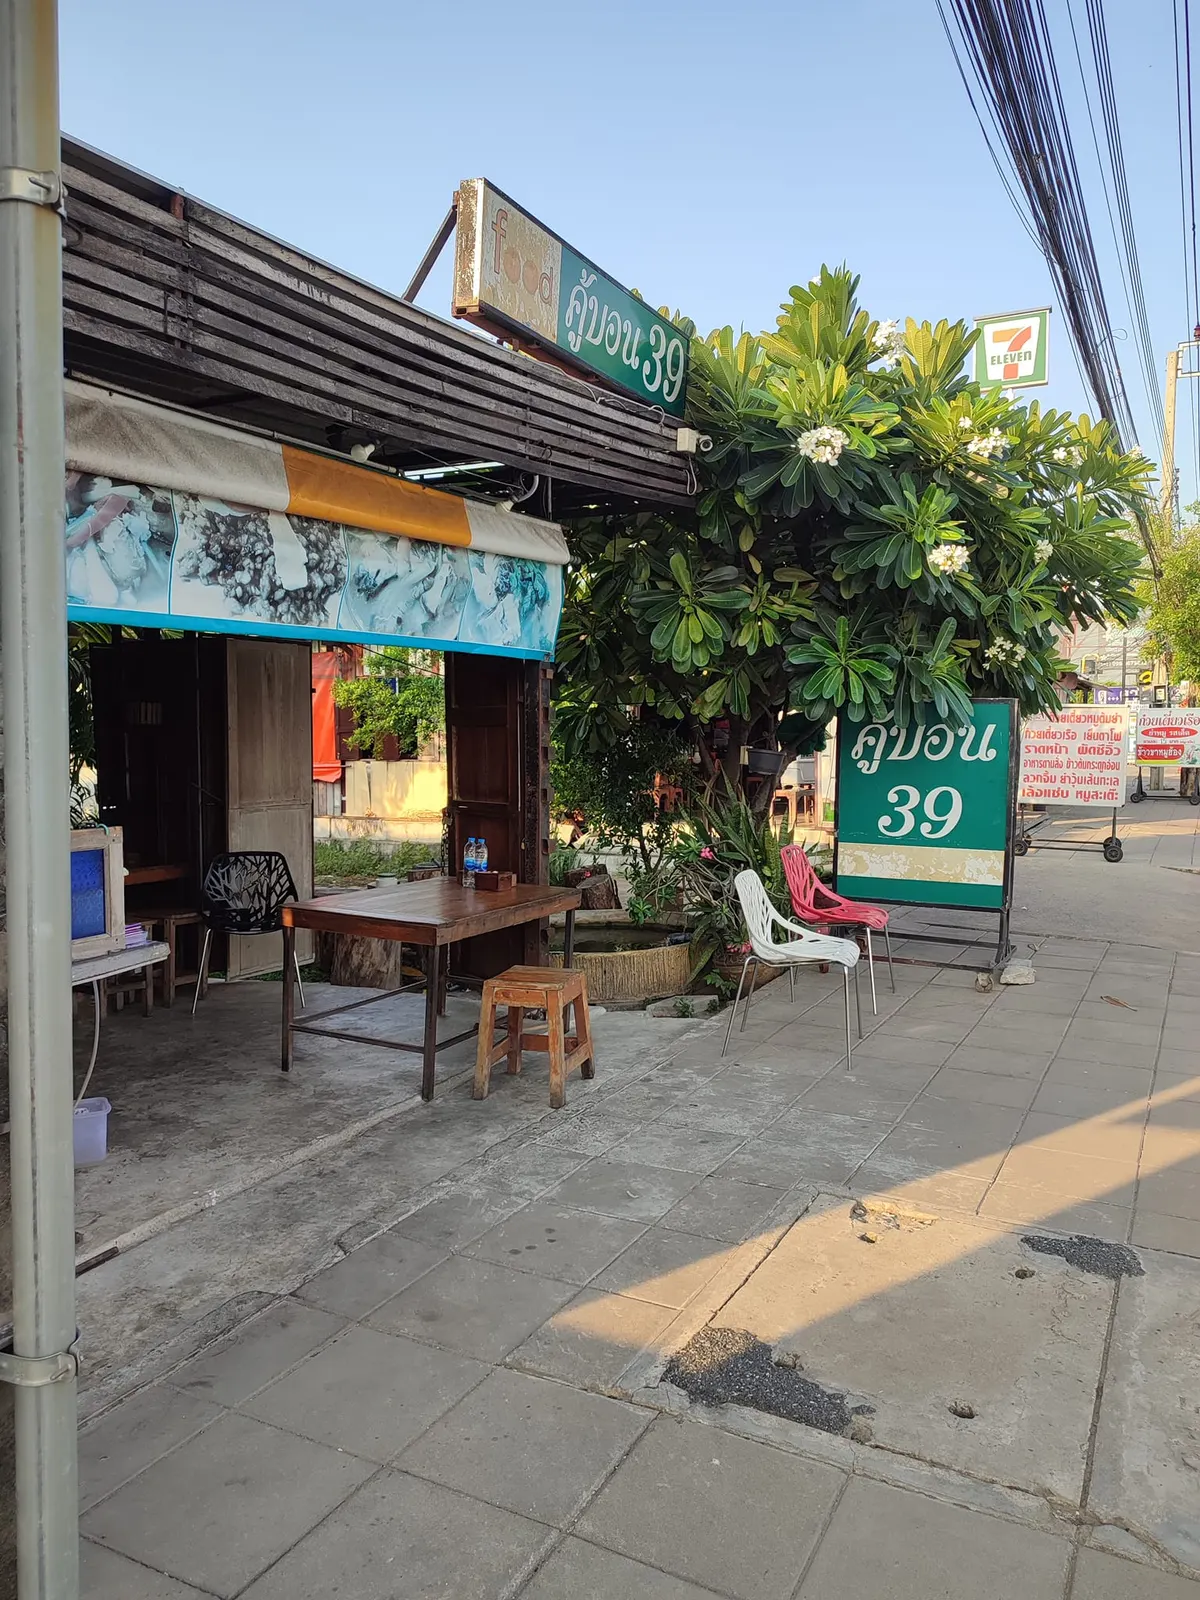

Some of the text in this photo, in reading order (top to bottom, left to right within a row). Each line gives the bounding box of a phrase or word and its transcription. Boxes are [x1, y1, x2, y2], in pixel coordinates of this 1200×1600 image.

[565, 268, 685, 403] คู้บอน 39
[992, 325, 1032, 380] 7
[1023, 755, 1064, 769] อาหารตามสั่ง
[1024, 743, 1069, 755] ราดหน้า
[877, 784, 963, 839] 39
